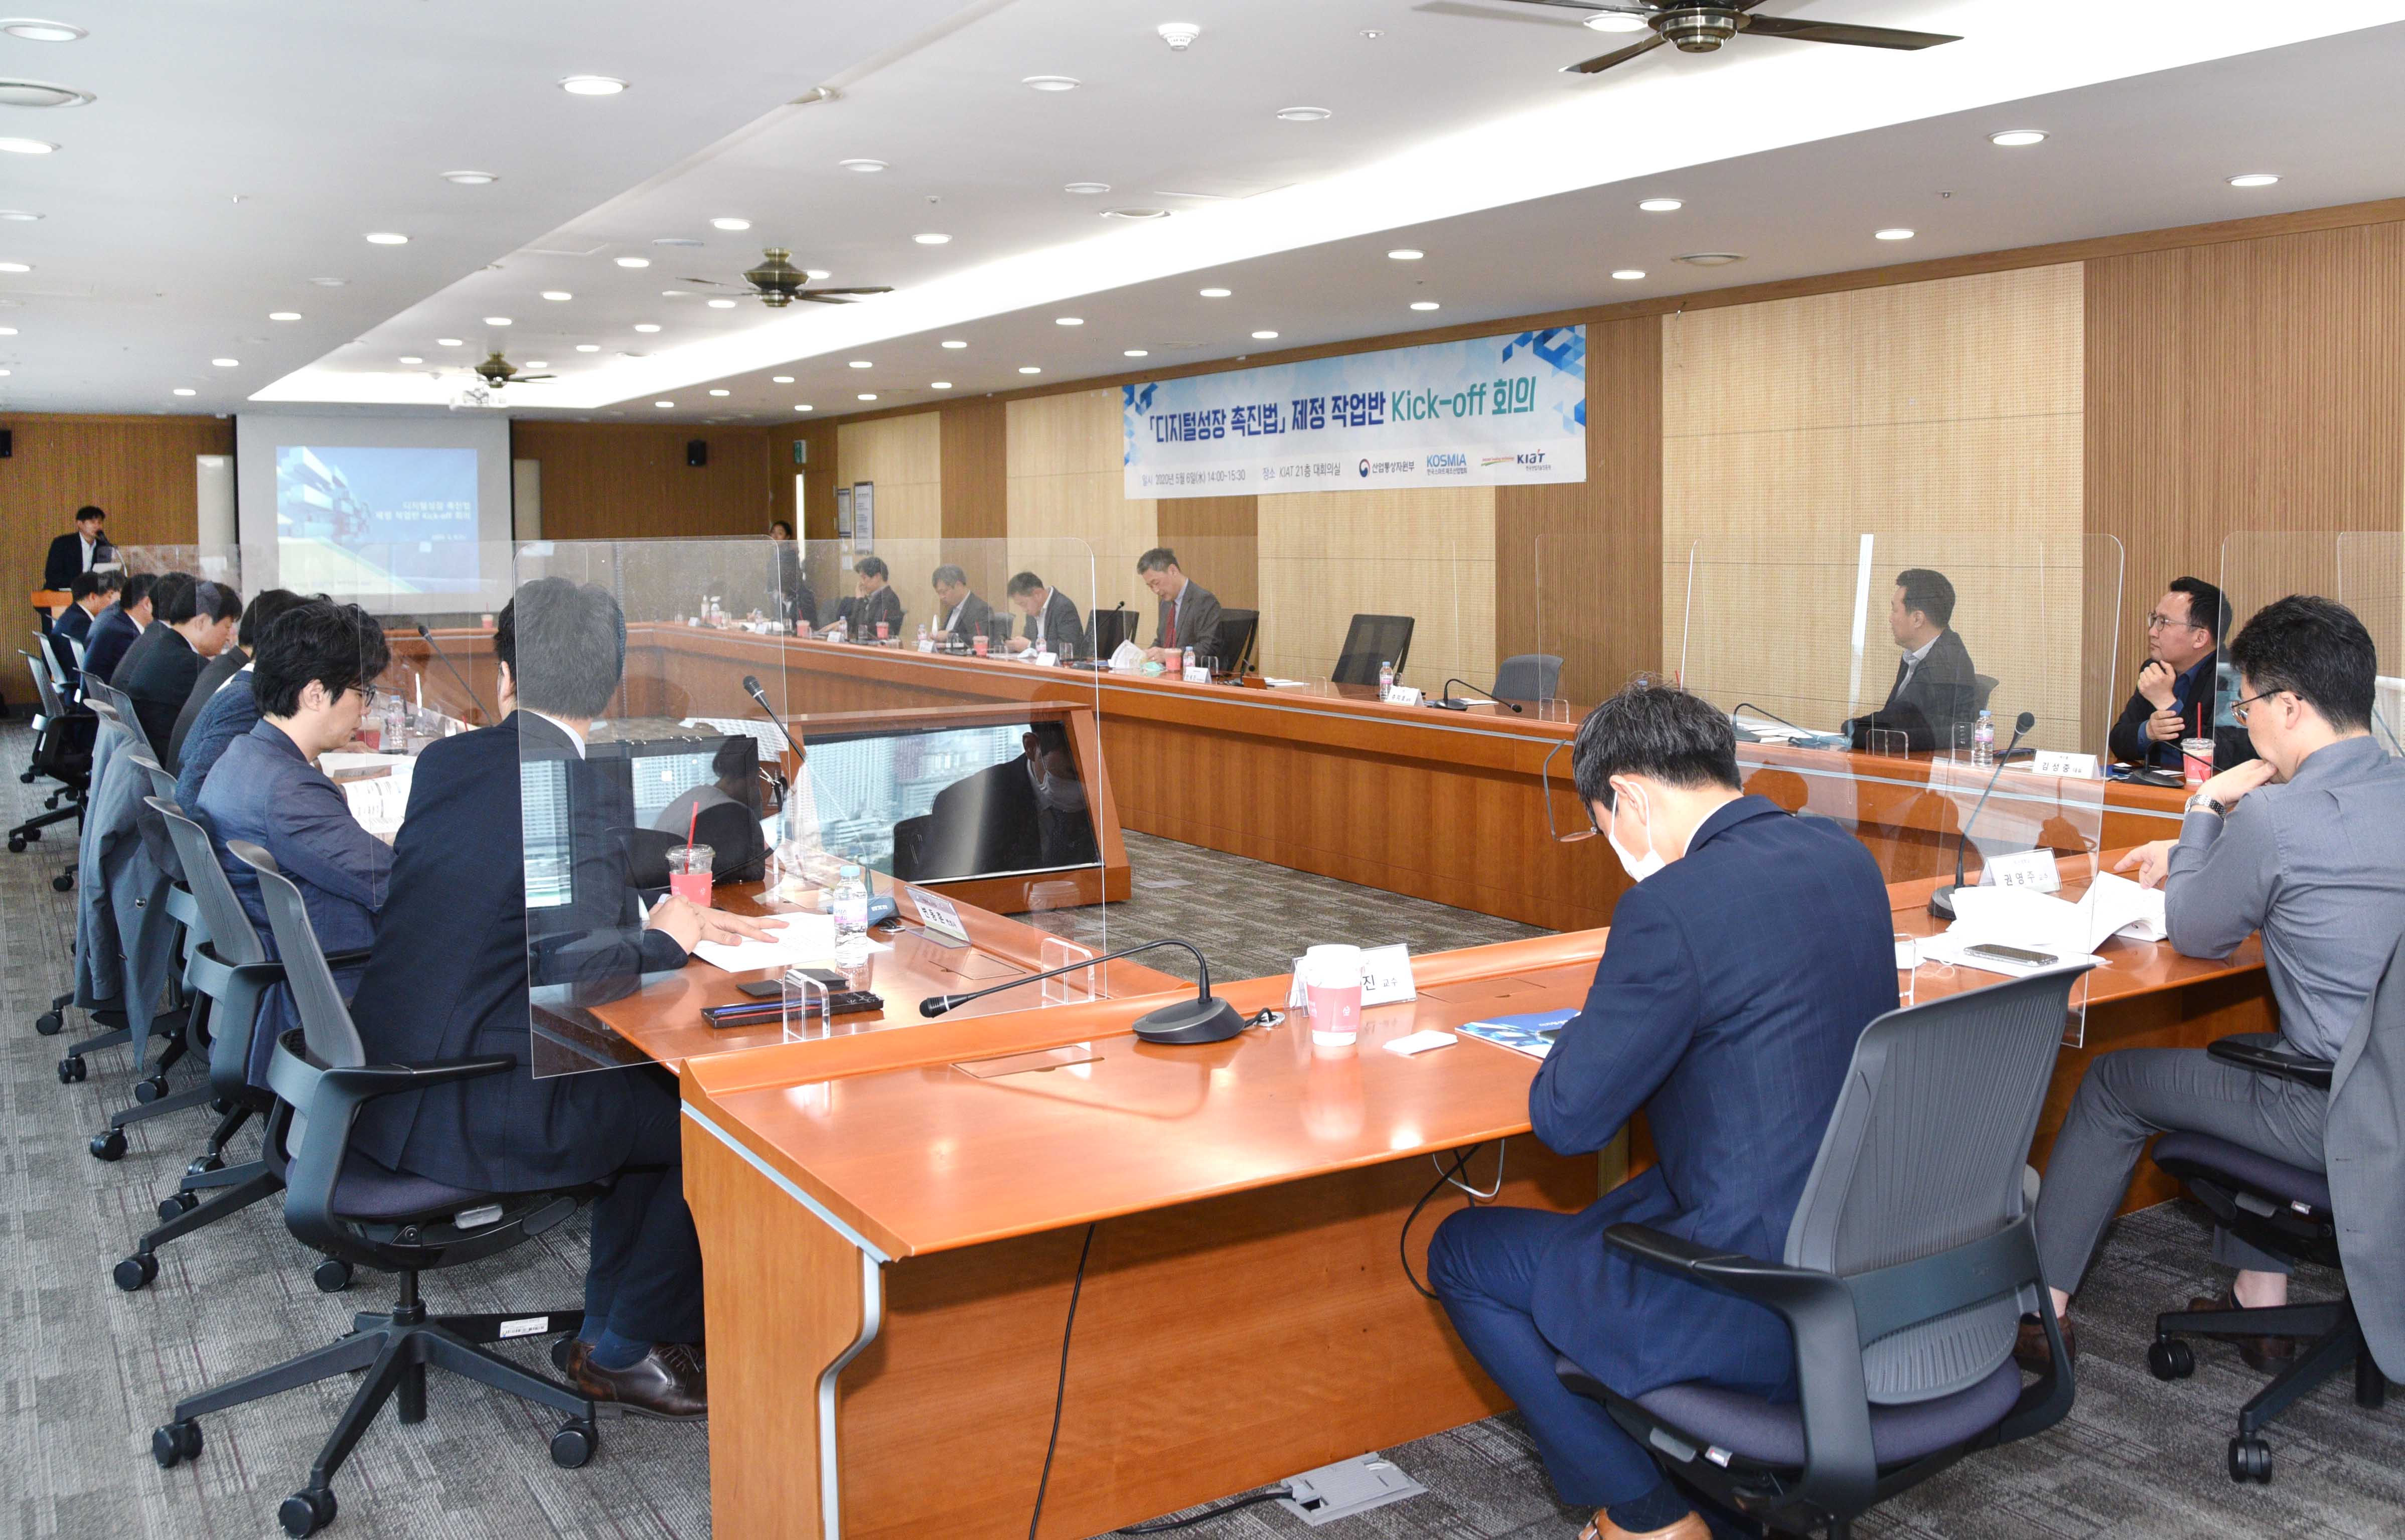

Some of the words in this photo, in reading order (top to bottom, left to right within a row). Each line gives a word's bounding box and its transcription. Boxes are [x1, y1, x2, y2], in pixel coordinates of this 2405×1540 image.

[1292, 397, 1325, 430] 제정
[1332, 391, 1386, 427] 작업반
[1392, 382, 1486, 421] Kick-off
[1492, 376, 1537, 415] 회의
[1372, 460, 1415, 474] 산업통상자원부
[1427, 453, 1467, 467] KOSMIA
[1263, 466, 1276, 480] 장소
[1280, 466, 1294, 478] KIAT
[1295, 464, 1311, 478] 21층
[1313, 462, 1341, 476] 대회의실
[1383, 977, 1397, 987] 교수
